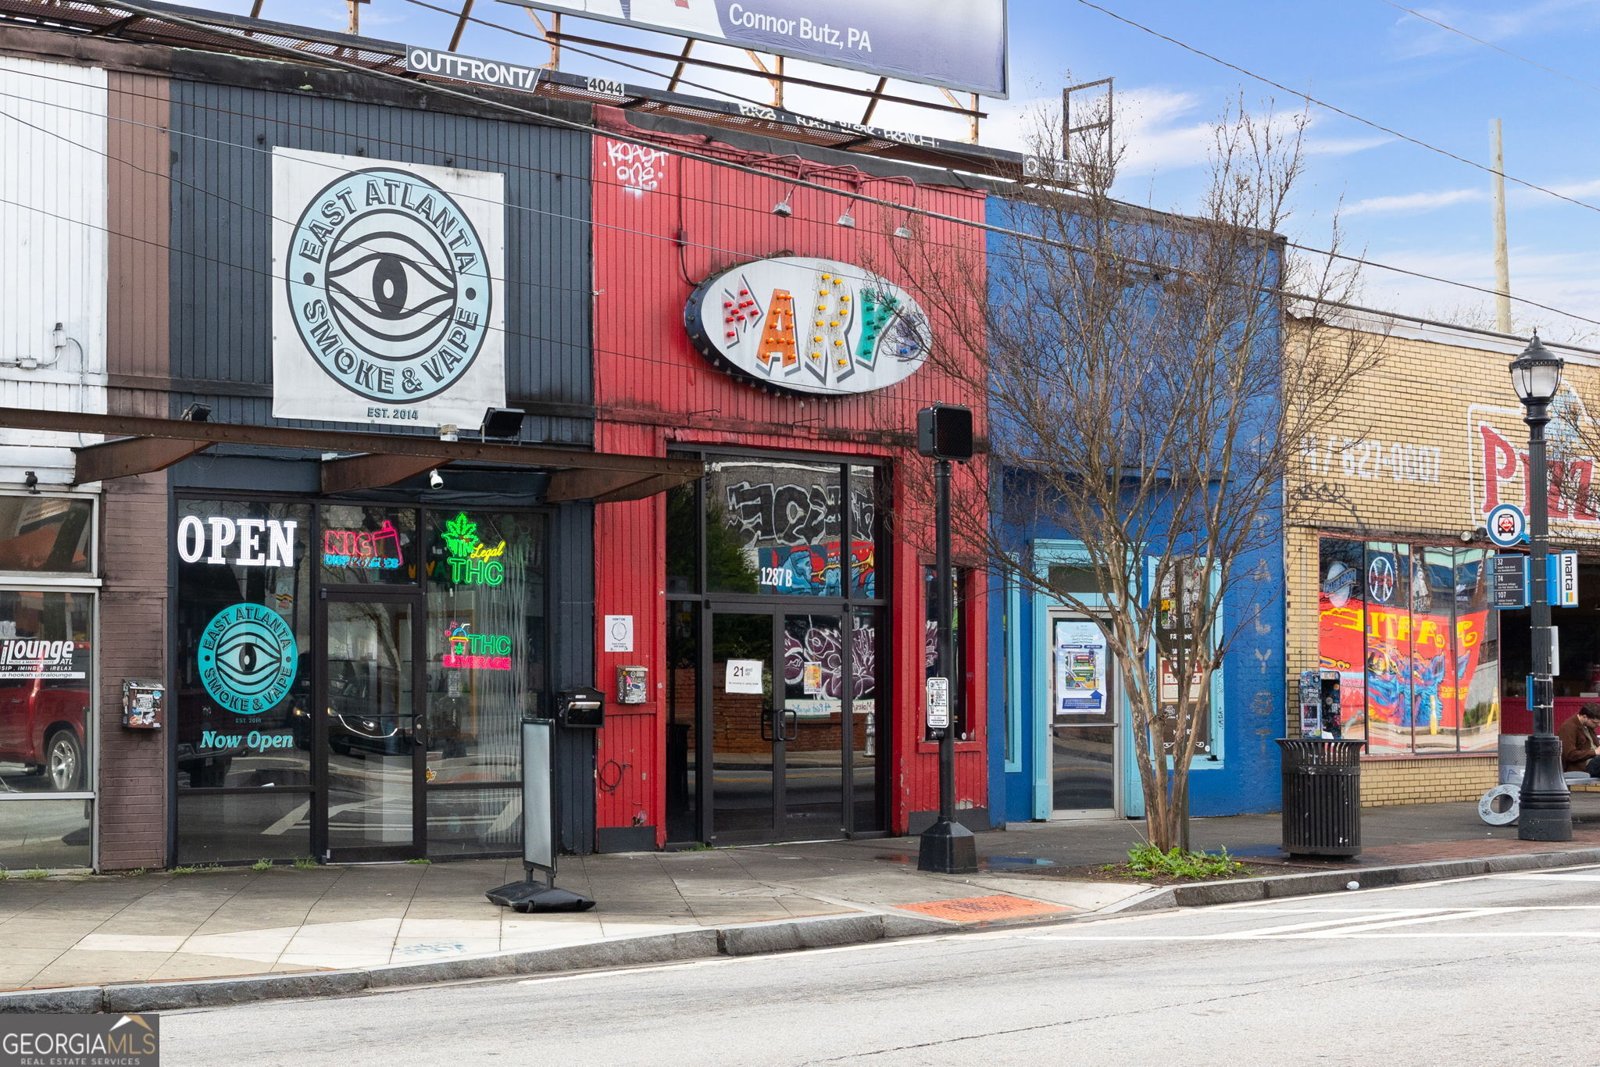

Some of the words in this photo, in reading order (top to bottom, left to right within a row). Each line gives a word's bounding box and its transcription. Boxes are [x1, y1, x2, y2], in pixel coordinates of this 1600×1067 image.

[729, 3, 796, 36] Connor
[800, 17, 844, 50] Butz,
[847, 27, 872, 52] PA
[589, 78, 623, 95] 4044
[298, 187, 357, 264] EAST
[365, 179, 478, 275] ATLANTA
[303, 299, 395, 394] SMOKE
[402, 367, 423, 393] &
[421, 307, 479, 383] VAPE
[367, 407, 390, 419] EST.
[393, 408, 418, 420] 2014
[177, 515, 297, 567] OPEN
[470, 541, 506, 562] Legal
[447, 557, 503, 586] THC
[761, 567, 784, 586] 1287
[785, 569, 792, 587] B
[1564, 556, 1574, 591] marta
[203, 613, 232, 650] EAST
[235, 607, 292, 651] ATLANTA
[467, 634, 511, 655] THC
[442, 655, 511, 670] BEVERAGE
[733, 665, 744, 677] 21
[204, 667, 249, 711] SMOKE
[252, 699, 263, 710] &
[264, 667, 293, 704] VAPE
[200, 731, 242, 748] Now
[247, 731, 294, 752] Open
